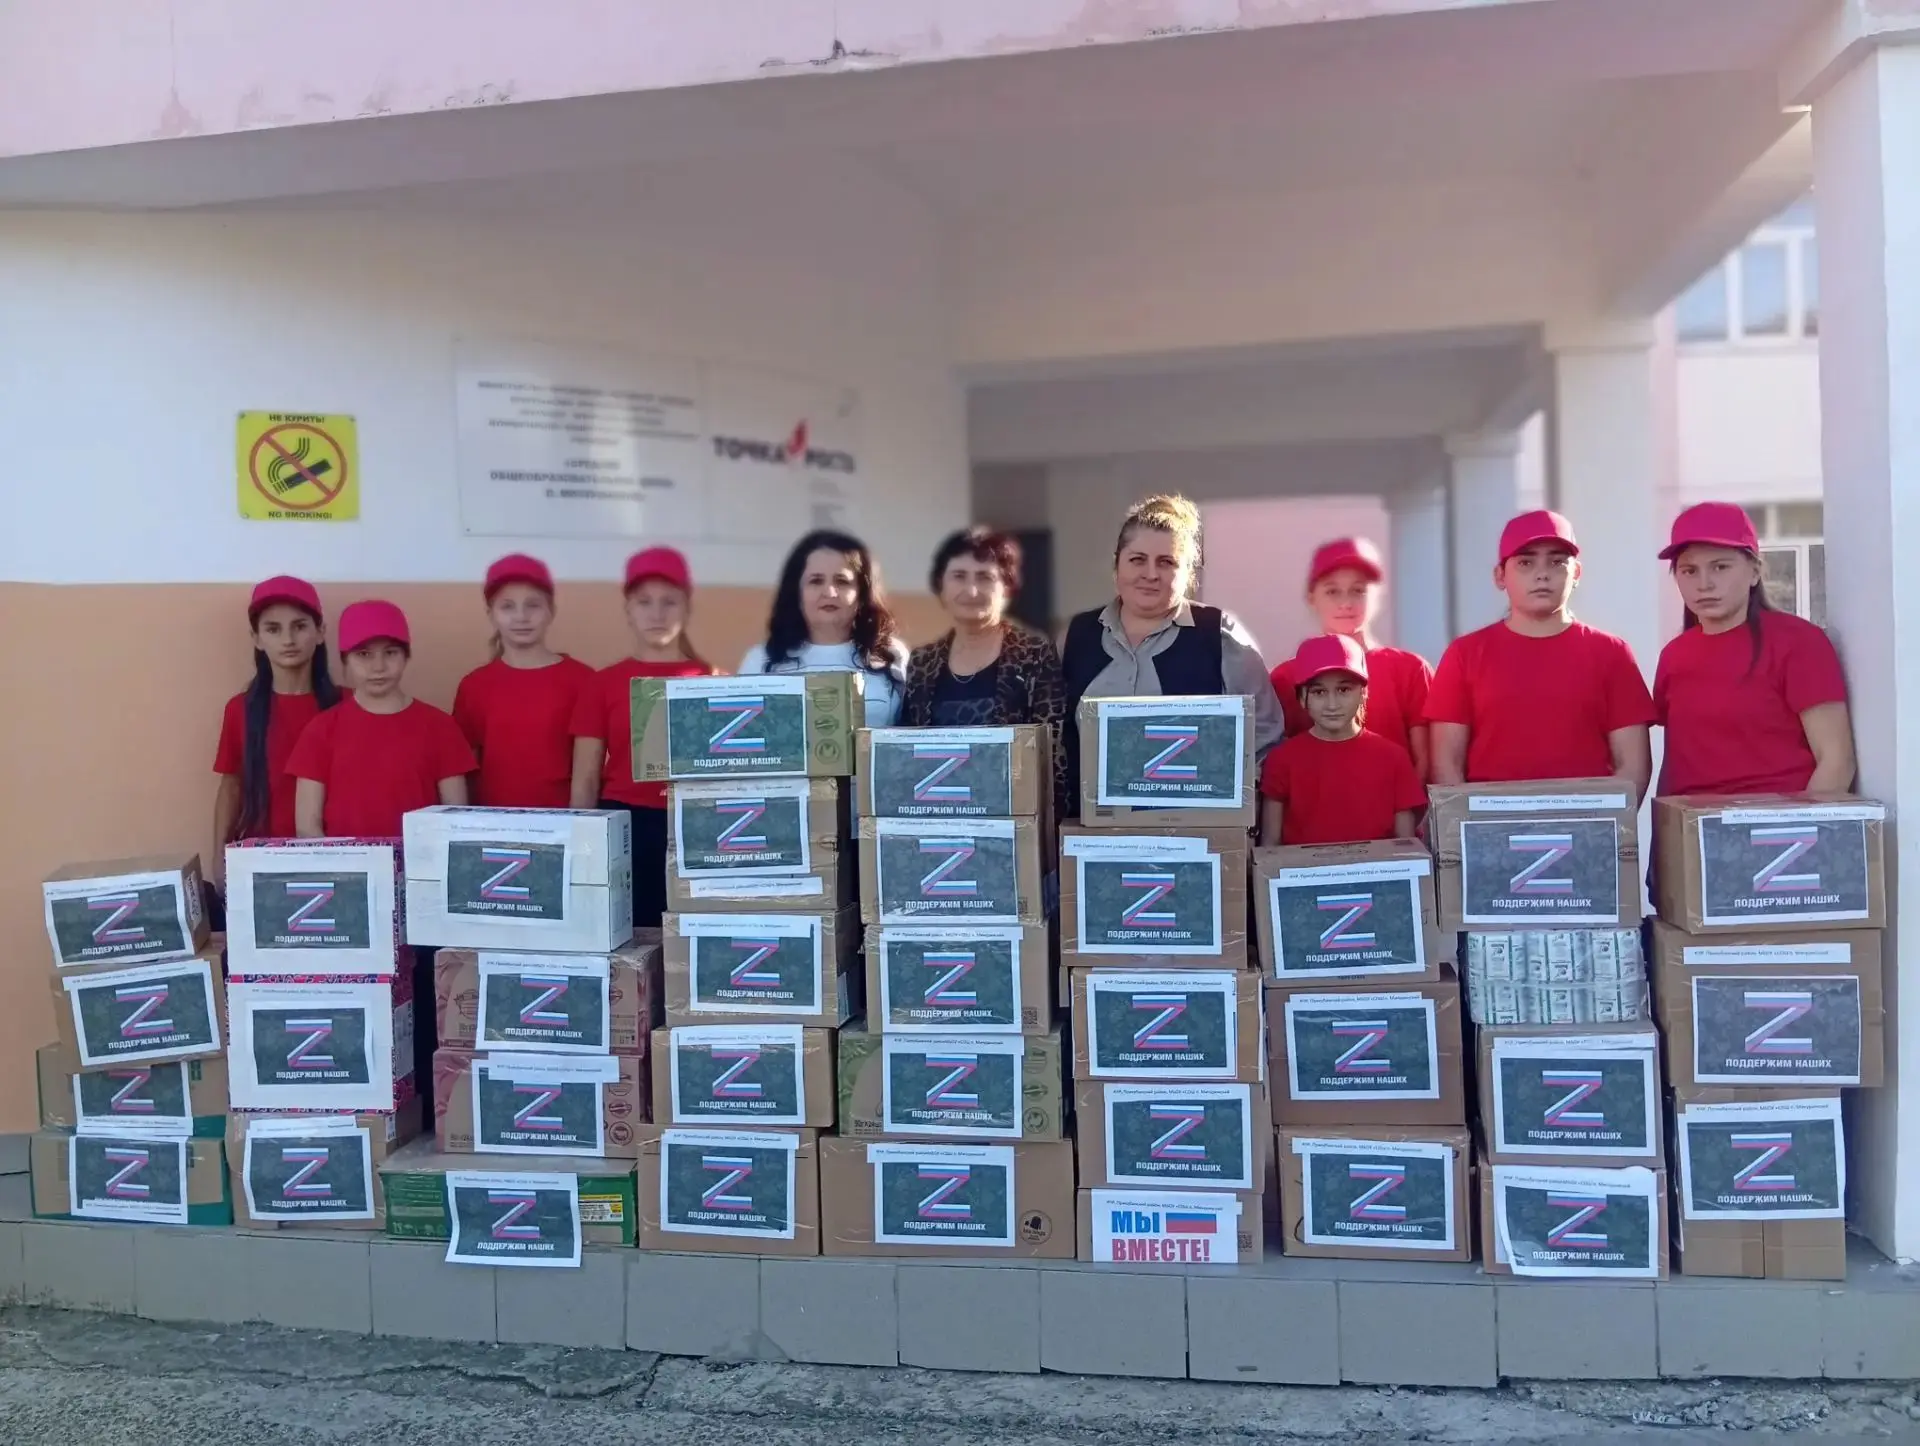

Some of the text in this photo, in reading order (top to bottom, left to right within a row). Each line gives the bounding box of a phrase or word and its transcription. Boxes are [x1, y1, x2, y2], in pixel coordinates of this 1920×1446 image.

[285, 511, 333, 519] SMOKING!
[694, 757, 781, 768] ПОДДЕРЖИМ НАШИХ
[1128, 783, 1180, 791] ПОДДЕРЖИМ
[899, 806, 986, 815] ПОДДЕРЖИМ НАШИХ
[704, 854, 753, 863] ПОДДЕРЖИМ
[906, 901, 960, 910] ПОДДЕРЖИМ
[1493, 899, 1591, 908] ПОДДЕРЖИМ НАШИХ
[1734, 895, 1840, 908] ПОДДЕРЖИМ НАШИХ
[468, 902, 515, 911] ПОДДЕРЖИМ
[275, 935, 322, 943] ПОДДЕРЖИМ
[82, 940, 163, 955] ПОДДЕРЖИМ НАШИХ
[1306, 953, 1360, 962] ПОДДЕРЖИМ
[717, 990, 794, 999] ПОДДЕРЖИМ НАШИХ
[911, 1010, 961, 1018] ПОДДЕРЖИМ
[505, 1028, 583, 1038] ПОДДЕРЖИМ НАШИХ
[109, 1034, 190, 1049] ПОДДЕРЖИМ НАШИХ
[1119, 1053, 1172, 1061] ПОДДЕРЖИМ
[1726, 1058, 1832, 1068] ПОДДЕРЖИМ НАШИХ
[276, 1071, 322, 1079] ПОДДЕРЖИМ
[1320, 1075, 1406, 1085] ПОДДЕРЖИМ НАШИХ
[912, 1111, 962, 1120] ПОДДЕРЖИМ
[501, 1132, 548, 1140] ПОДДЕРЖИМ
[1528, 1130, 1586, 1140] ПОДДЕРЖИМ
[1136, 1162, 1189, 1171] ПОДДЕРЖИМ
[1718, 1194, 1814, 1204] ПОДДЕРЖИМ НАШИХ
[272, 1200, 318, 1208] ПОДДЕРЖИМ
[688, 1211, 766, 1222] ПОДДЕРЖИМ НАШИХ
[904, 1222, 955, 1230] ПОДДЕРЖИМ
[1111, 1210, 1160, 1233] МЫ
[1335, 1222, 1422, 1232] ПОДДЕРЖИМ НАШИХ
[478, 1242, 554, 1252] ПОДДЕРЖИМ НАШИХ
[1111, 1238, 1210, 1262] ВМЕСТЕ!
[1533, 1252, 1590, 1260] ПОДДЕРЖИМ
